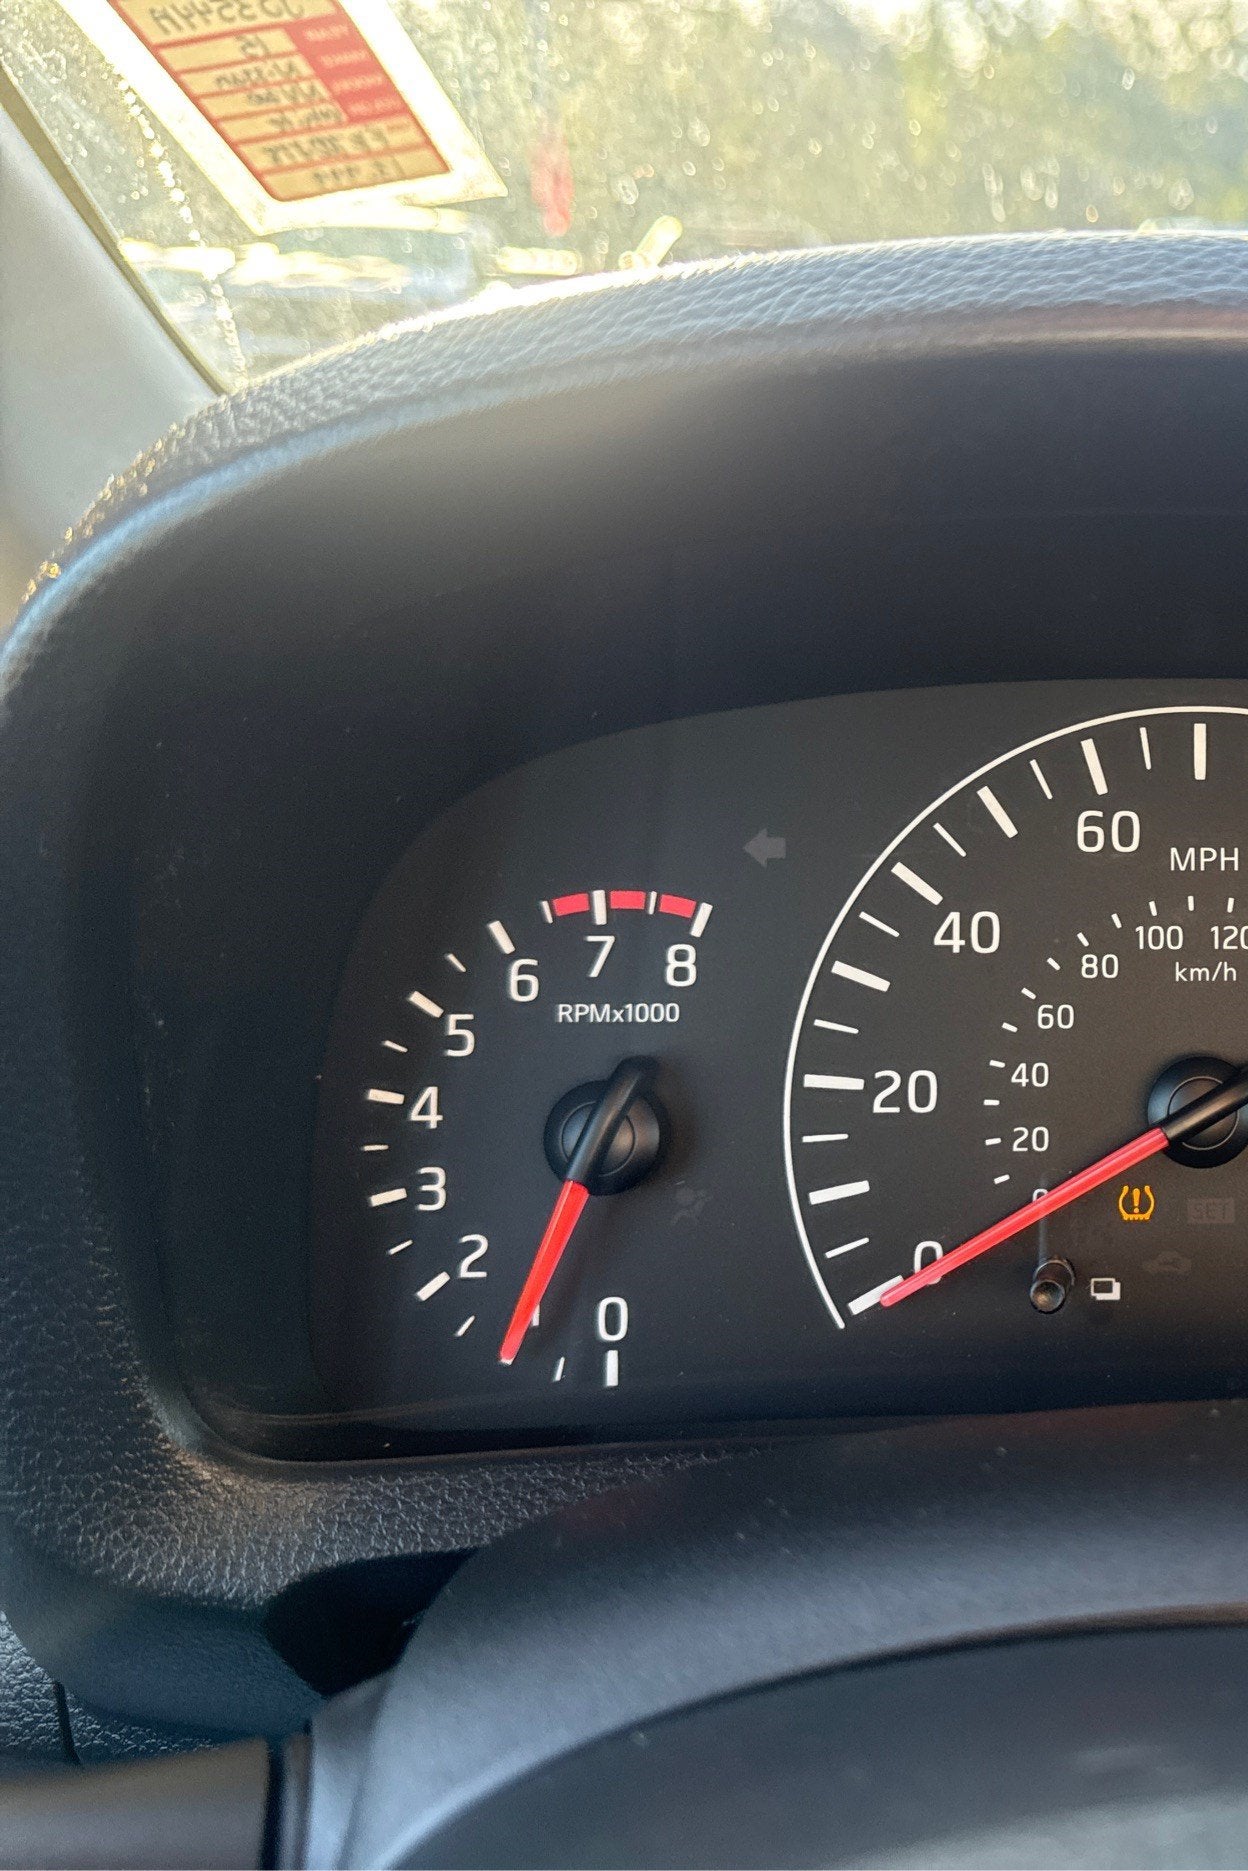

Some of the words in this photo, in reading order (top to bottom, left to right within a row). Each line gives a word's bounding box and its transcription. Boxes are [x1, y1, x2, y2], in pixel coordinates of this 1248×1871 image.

[1076, 810, 1141, 853] 60
[1170, 847, 1239, 872] MPH
[933, 911, 1001, 954] 40
[1135, 925, 1184, 951] 100
[585, 936, 616, 977] 7
[665, 944, 697, 987] 8
[1080, 954, 1119, 979] 80
[1174, 961, 1237, 983] km/h
[508, 959, 539, 1002] 6
[444, 1012, 475, 1057] 5
[556, 1003, 680, 1024] RPMx1000
[1037, 1004, 1075, 1030] 60
[872, 1070, 938, 1113] 20
[1011, 1062, 1050, 1088] 40
[409, 1086, 444, 1129] 4
[1012, 1126, 1050, 1152] 20
[417, 1167, 446, 1211] 3
[457, 1234, 489, 1278] 2
[596, 1296, 629, 1341] 0
